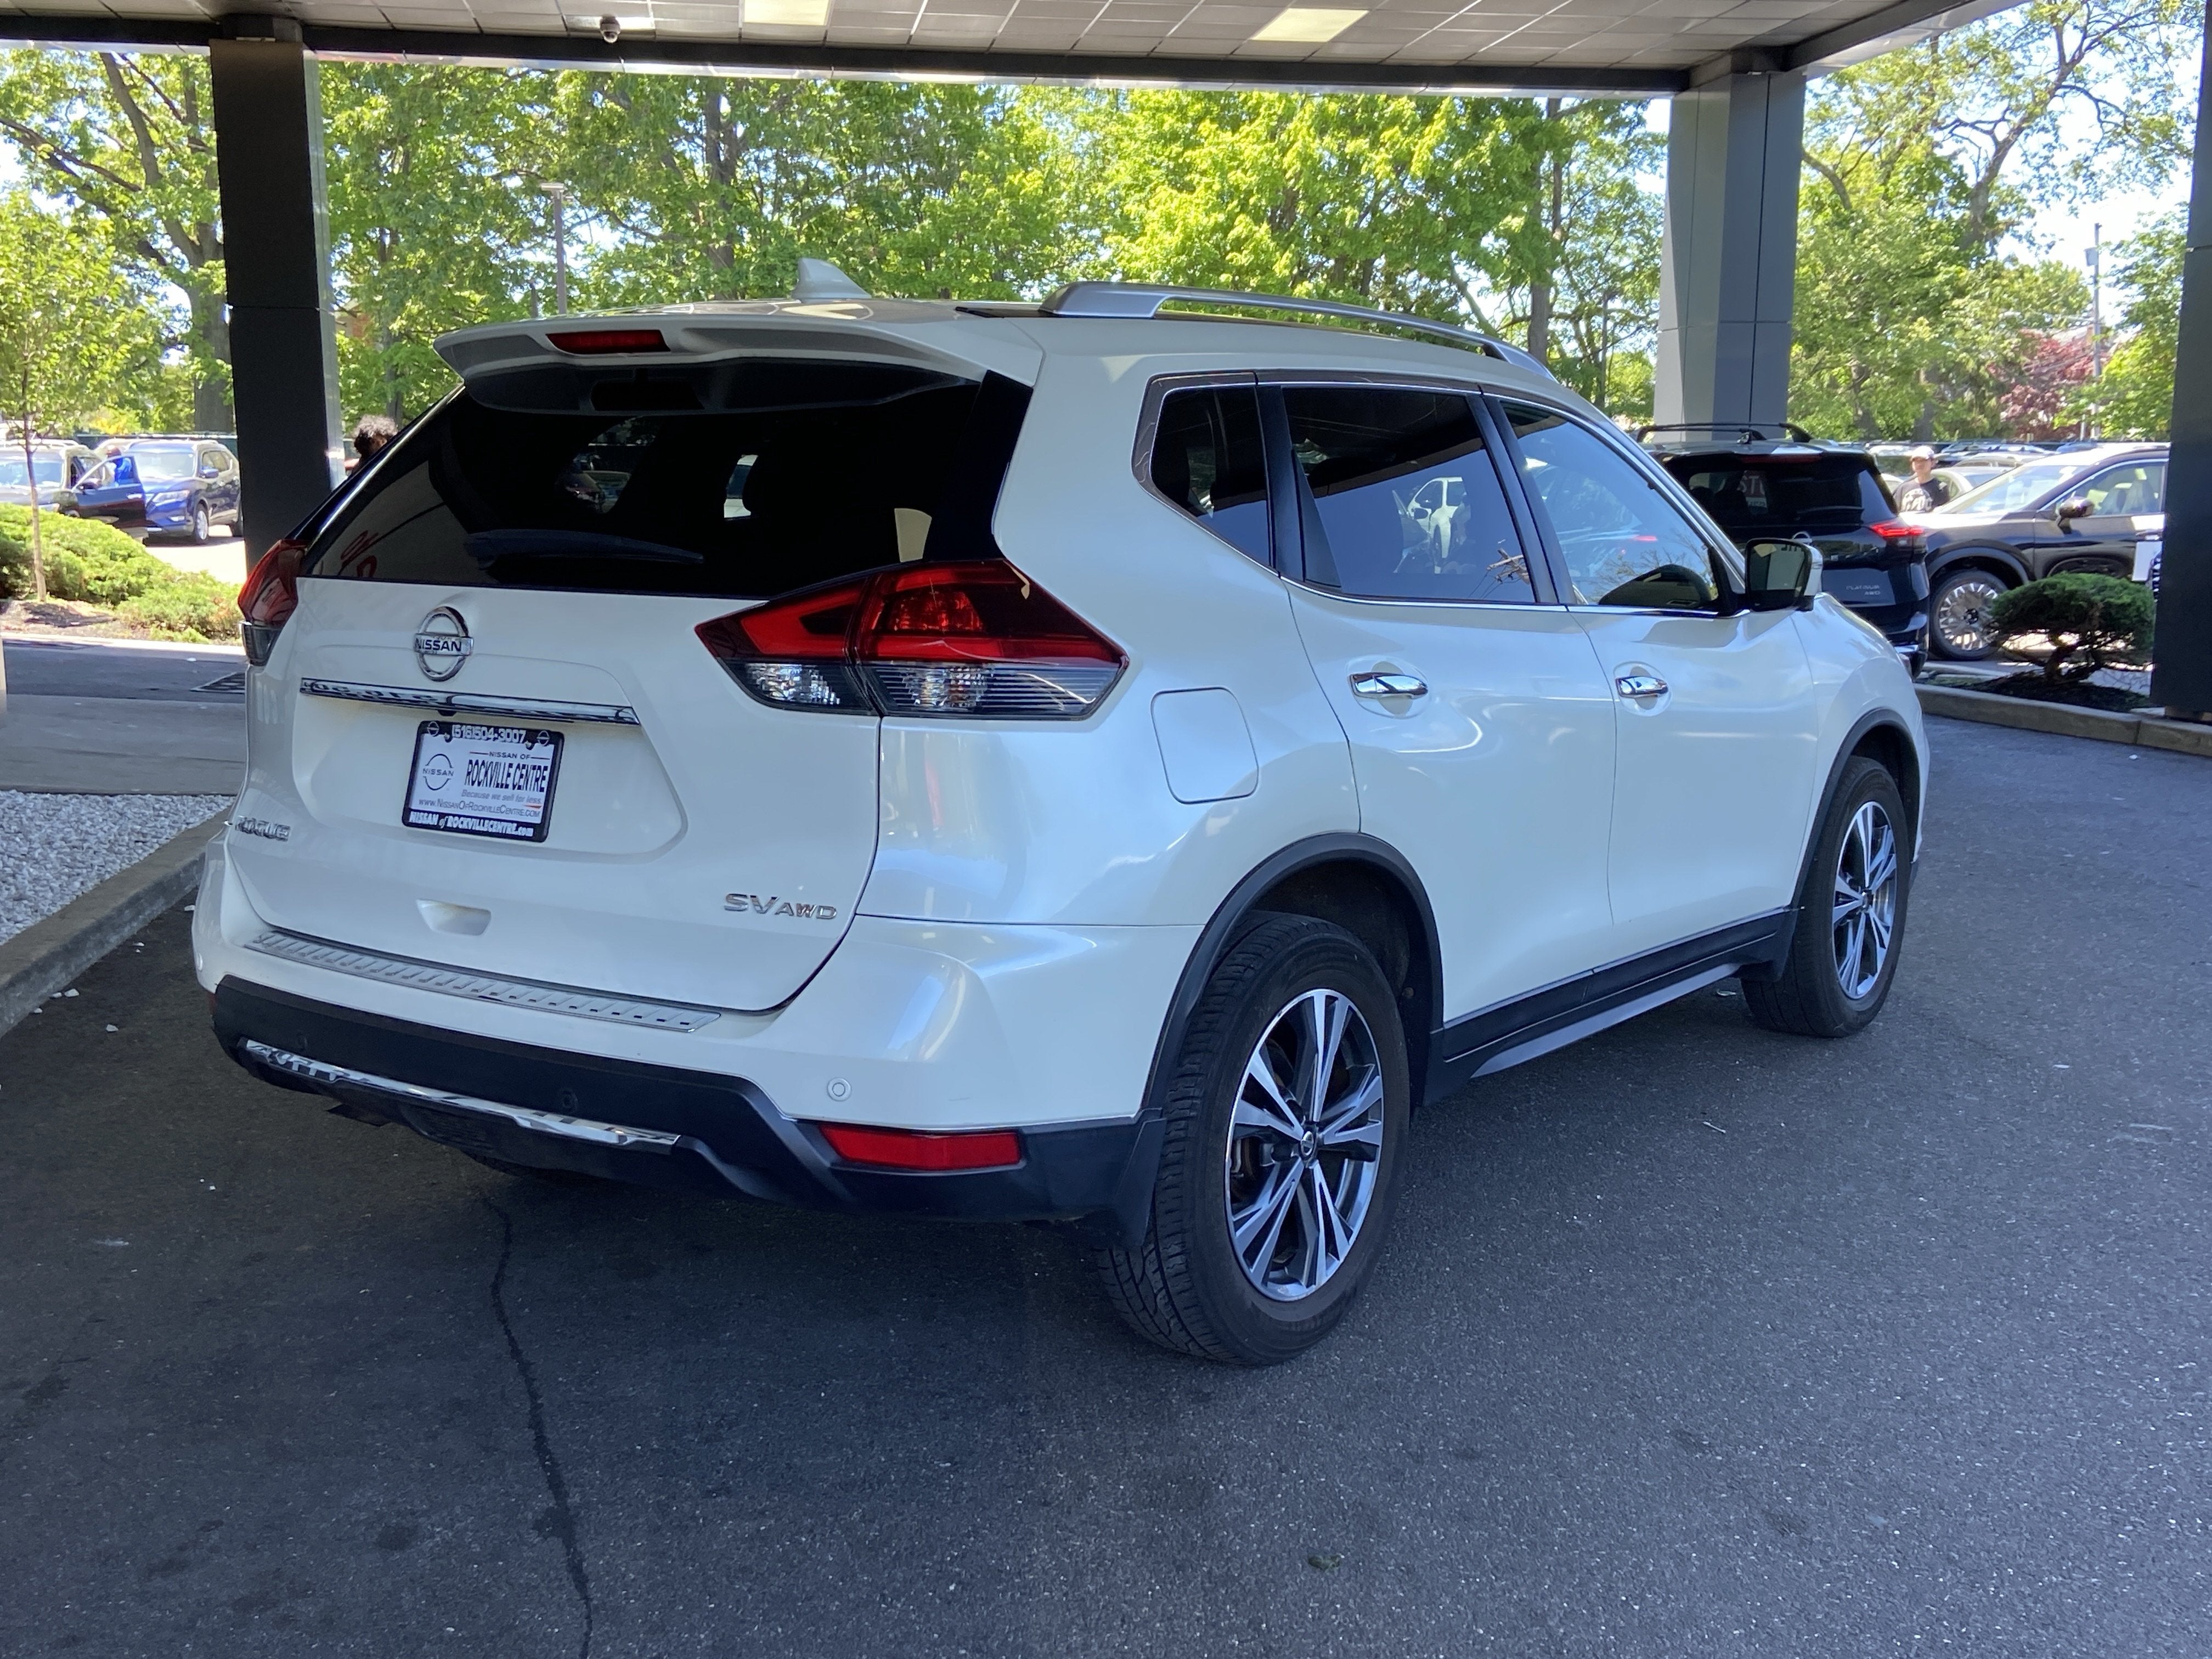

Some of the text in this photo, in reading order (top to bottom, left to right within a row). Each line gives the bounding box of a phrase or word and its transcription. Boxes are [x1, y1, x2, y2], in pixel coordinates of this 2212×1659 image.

[415, 638, 462, 652] NISSAN
[422, 768, 454, 777] NISSAN
[464, 759, 549, 793] ROCKVILLE CENTRE
[461, 789, 490, 799] Because
[502, 793, 515, 802] sell
[409, 811, 439, 826] NISSAN
